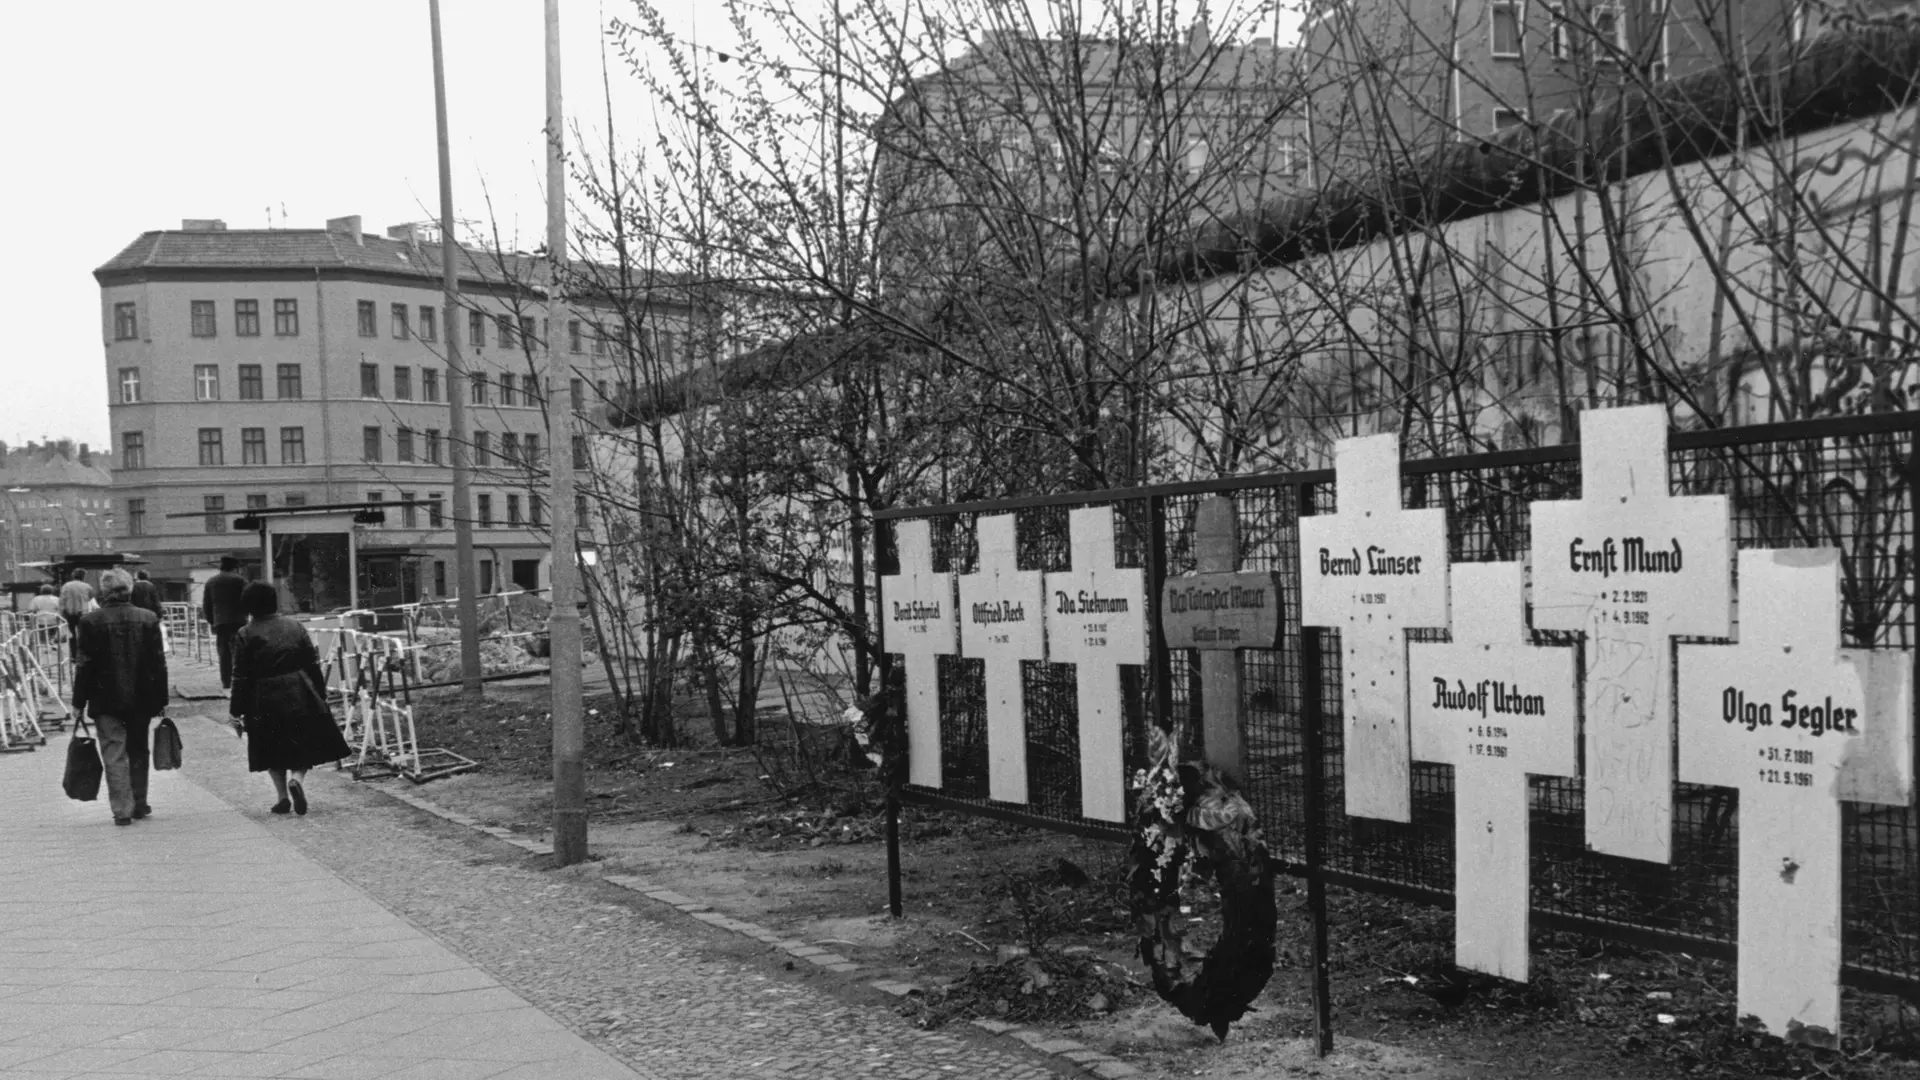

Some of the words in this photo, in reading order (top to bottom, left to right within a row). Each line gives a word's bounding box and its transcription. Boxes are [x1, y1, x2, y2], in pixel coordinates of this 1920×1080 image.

[1319, 547, 1361, 576] Bernd
[1367, 545, 1422, 576] Lünser
[1570, 537, 1618, 578] Ernst
[1622, 536, 1683, 573] Mund
[1078, 590, 1128, 614] Siekmann
[1432, 676, 1490, 719] Rudolf
[1492, 680, 1545, 716] Urban
[1722, 686, 1773, 732] Olga
[1780, 689, 1858, 737] Segler
